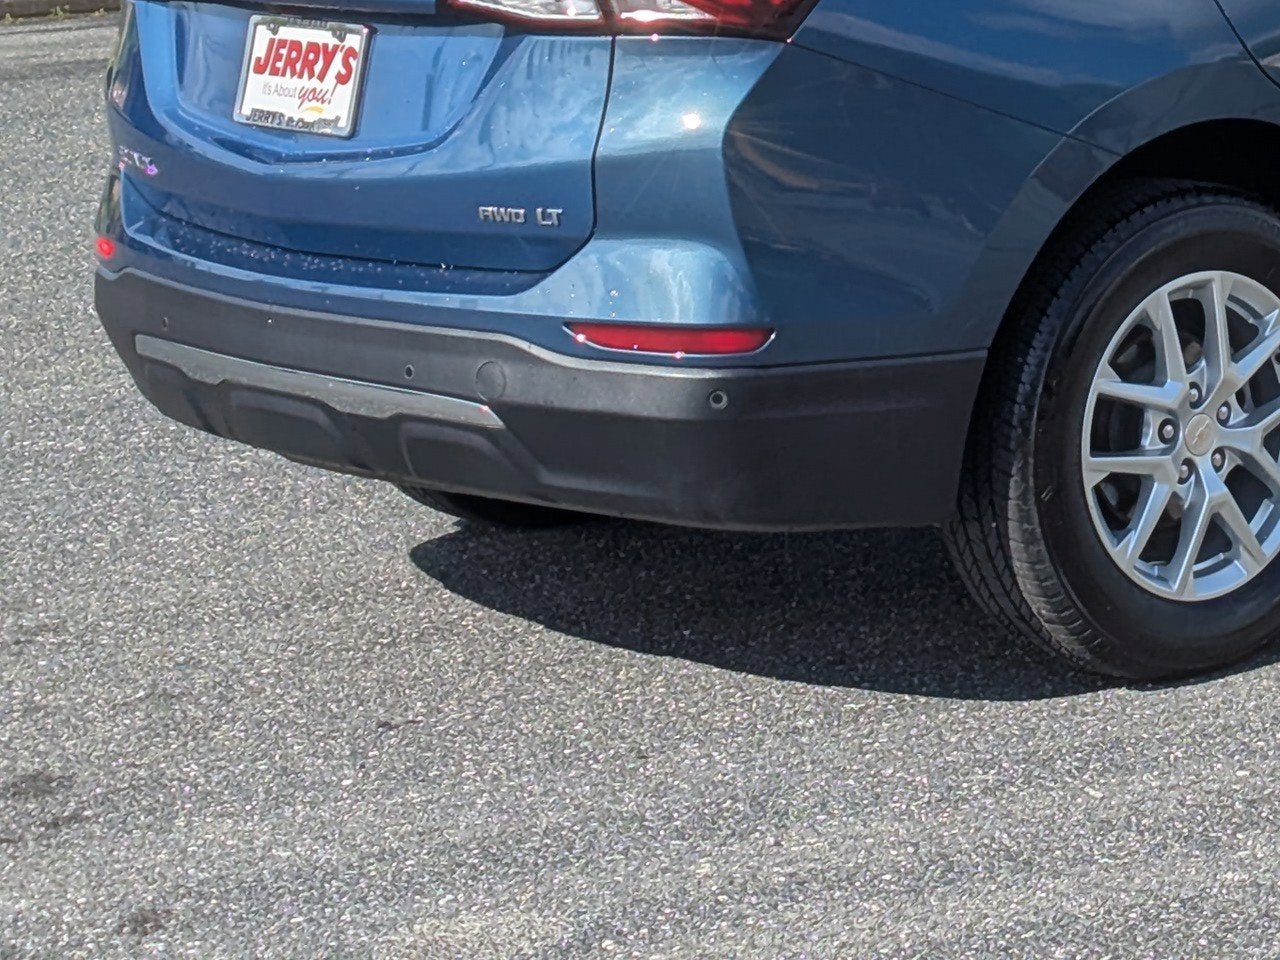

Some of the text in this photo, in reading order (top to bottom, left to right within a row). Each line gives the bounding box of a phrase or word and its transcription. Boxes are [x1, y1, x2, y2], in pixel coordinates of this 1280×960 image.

[253, 38, 358, 85] JERRY'S
[272, 83, 297, 98] About
[297, 82, 338, 110] you!
[479, 206, 563, 226] AWD LT
